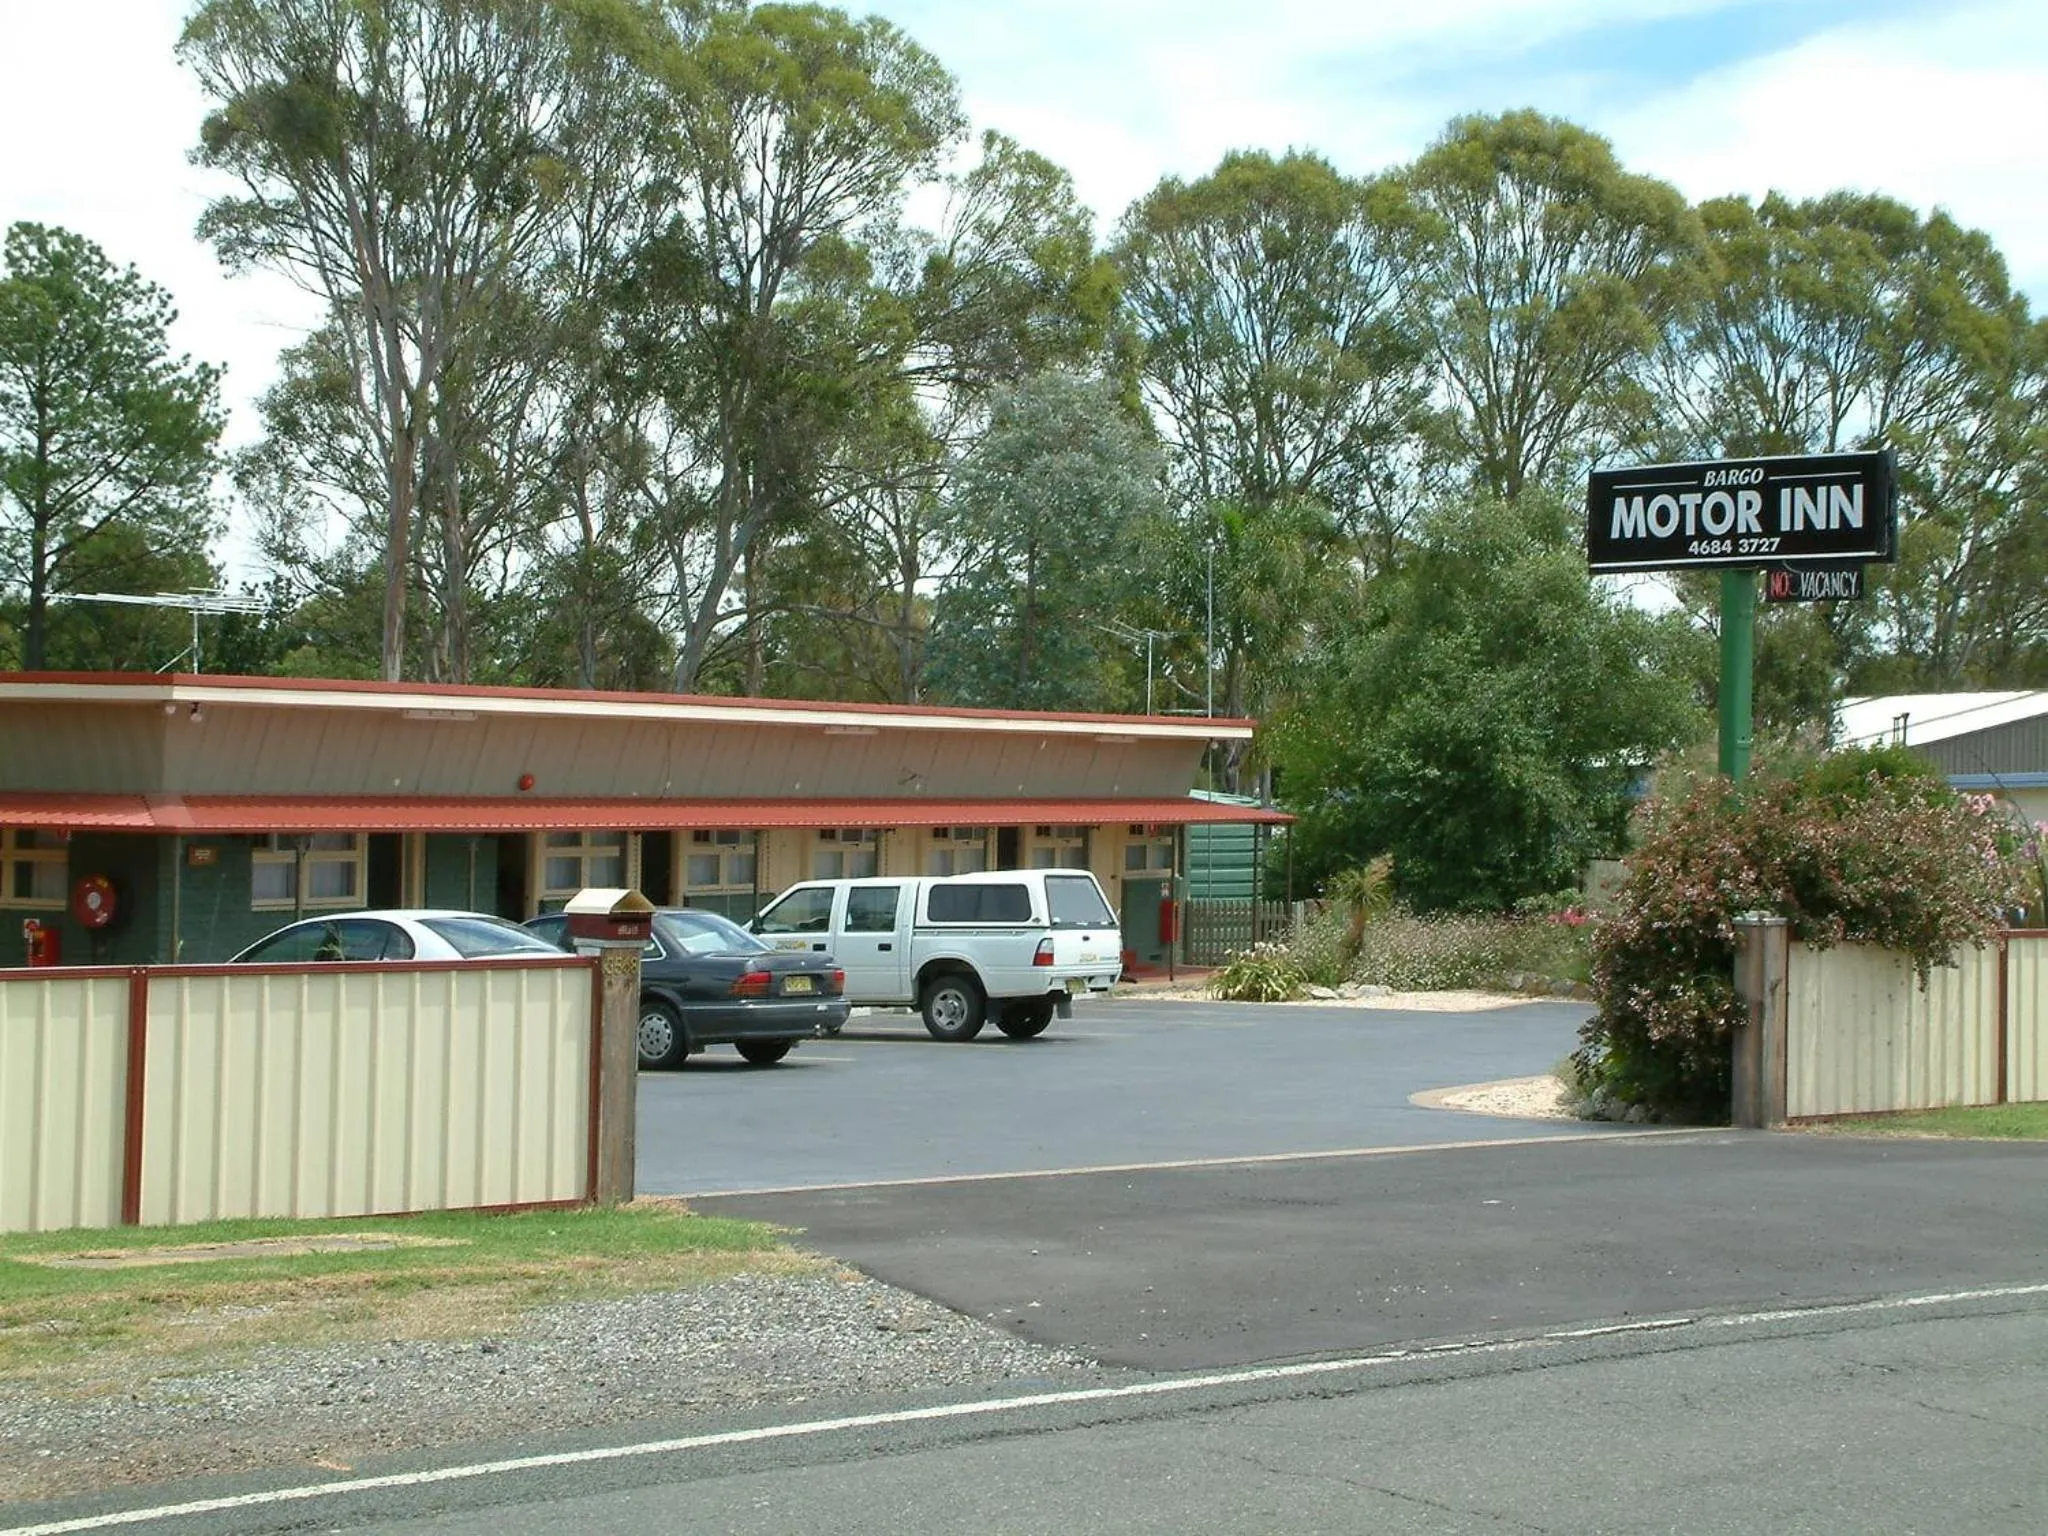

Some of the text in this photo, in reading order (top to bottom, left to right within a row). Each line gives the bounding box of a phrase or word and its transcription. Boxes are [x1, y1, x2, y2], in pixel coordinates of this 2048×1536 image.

[1703, 467, 1764, 487] BARGO
[1610, 484, 1864, 539] MOTOR INN
[1688, 537, 1781, 555] 4684 3727
[1770, 571, 1858, 598] NO VACANCY
